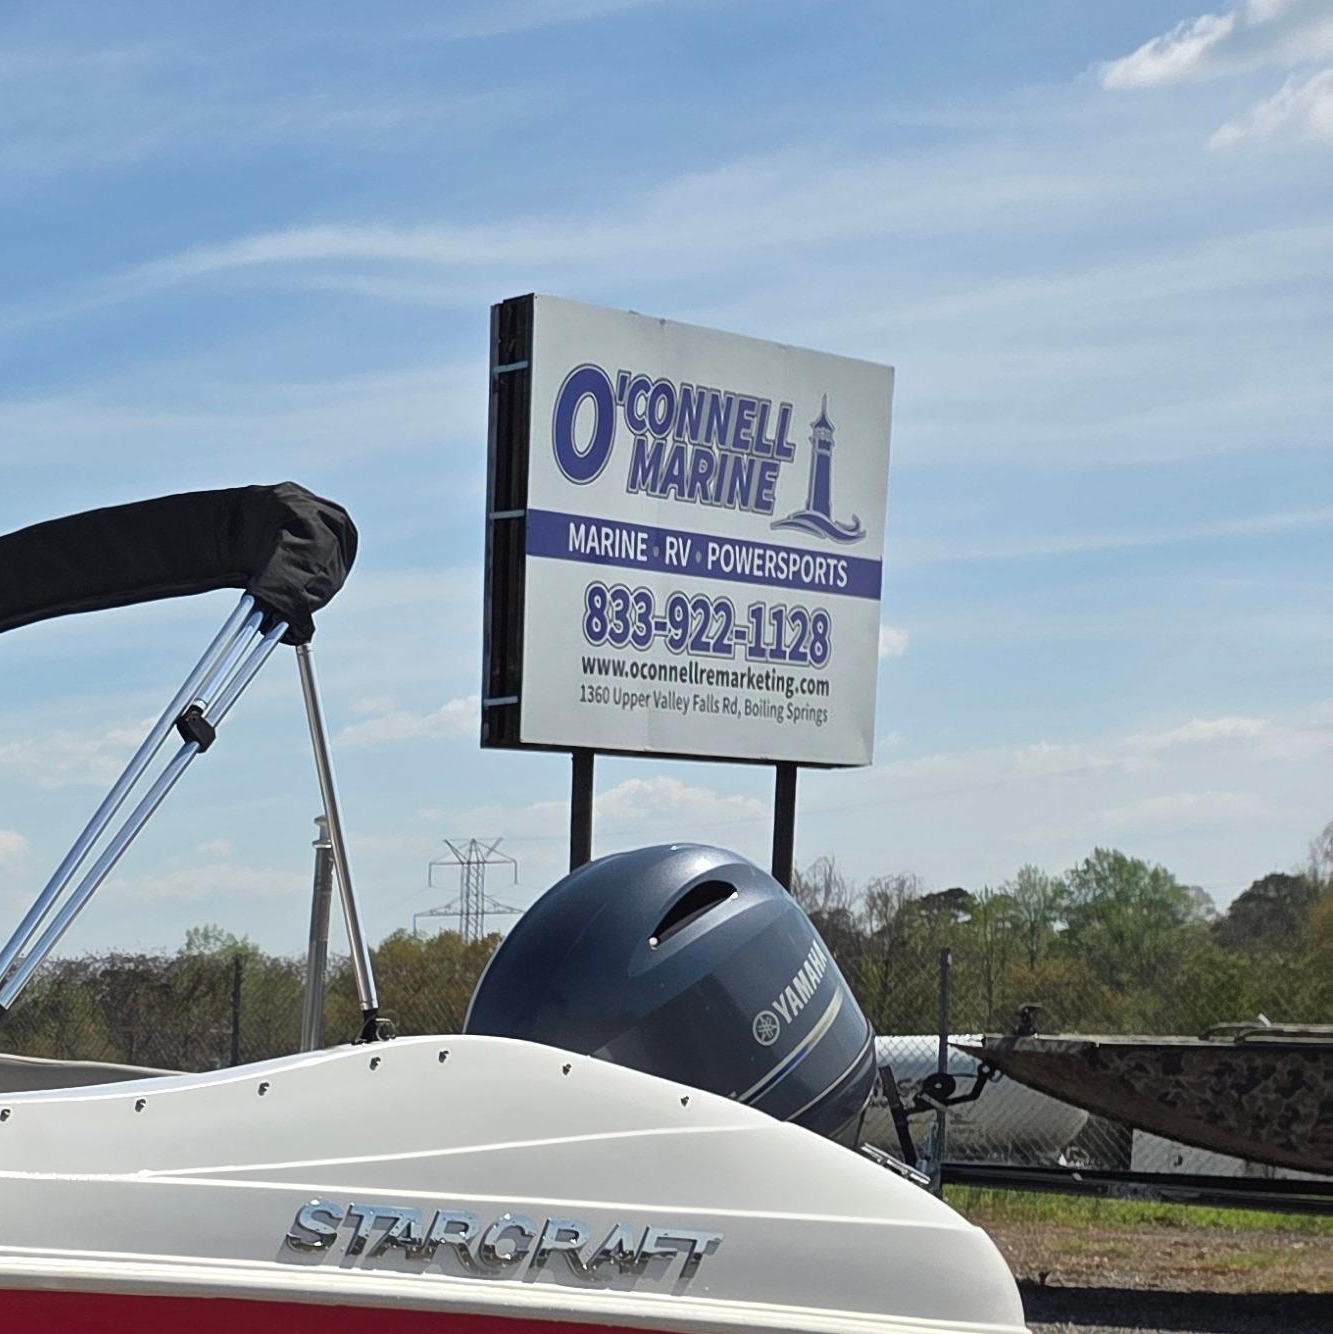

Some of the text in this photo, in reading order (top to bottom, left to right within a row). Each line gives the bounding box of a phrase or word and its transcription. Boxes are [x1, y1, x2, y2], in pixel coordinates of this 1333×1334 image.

[552, 363, 796, 485] O'CONNELL
[627, 434, 781, 515] MARINE
[568, 522, 849, 588] MARINE RV POWERSPORTS
[583, 581, 832, 669] 833-922-1128
[580, 684, 828, 727] 1360 Upper Valley Falls Rd, Boiling Springs
[582, 656, 830, 698] www.oconnellremarketing.com
[772, 940, 827, 1024] YAMAHA
[286, 1199, 726, 1281] STARCRAFT
